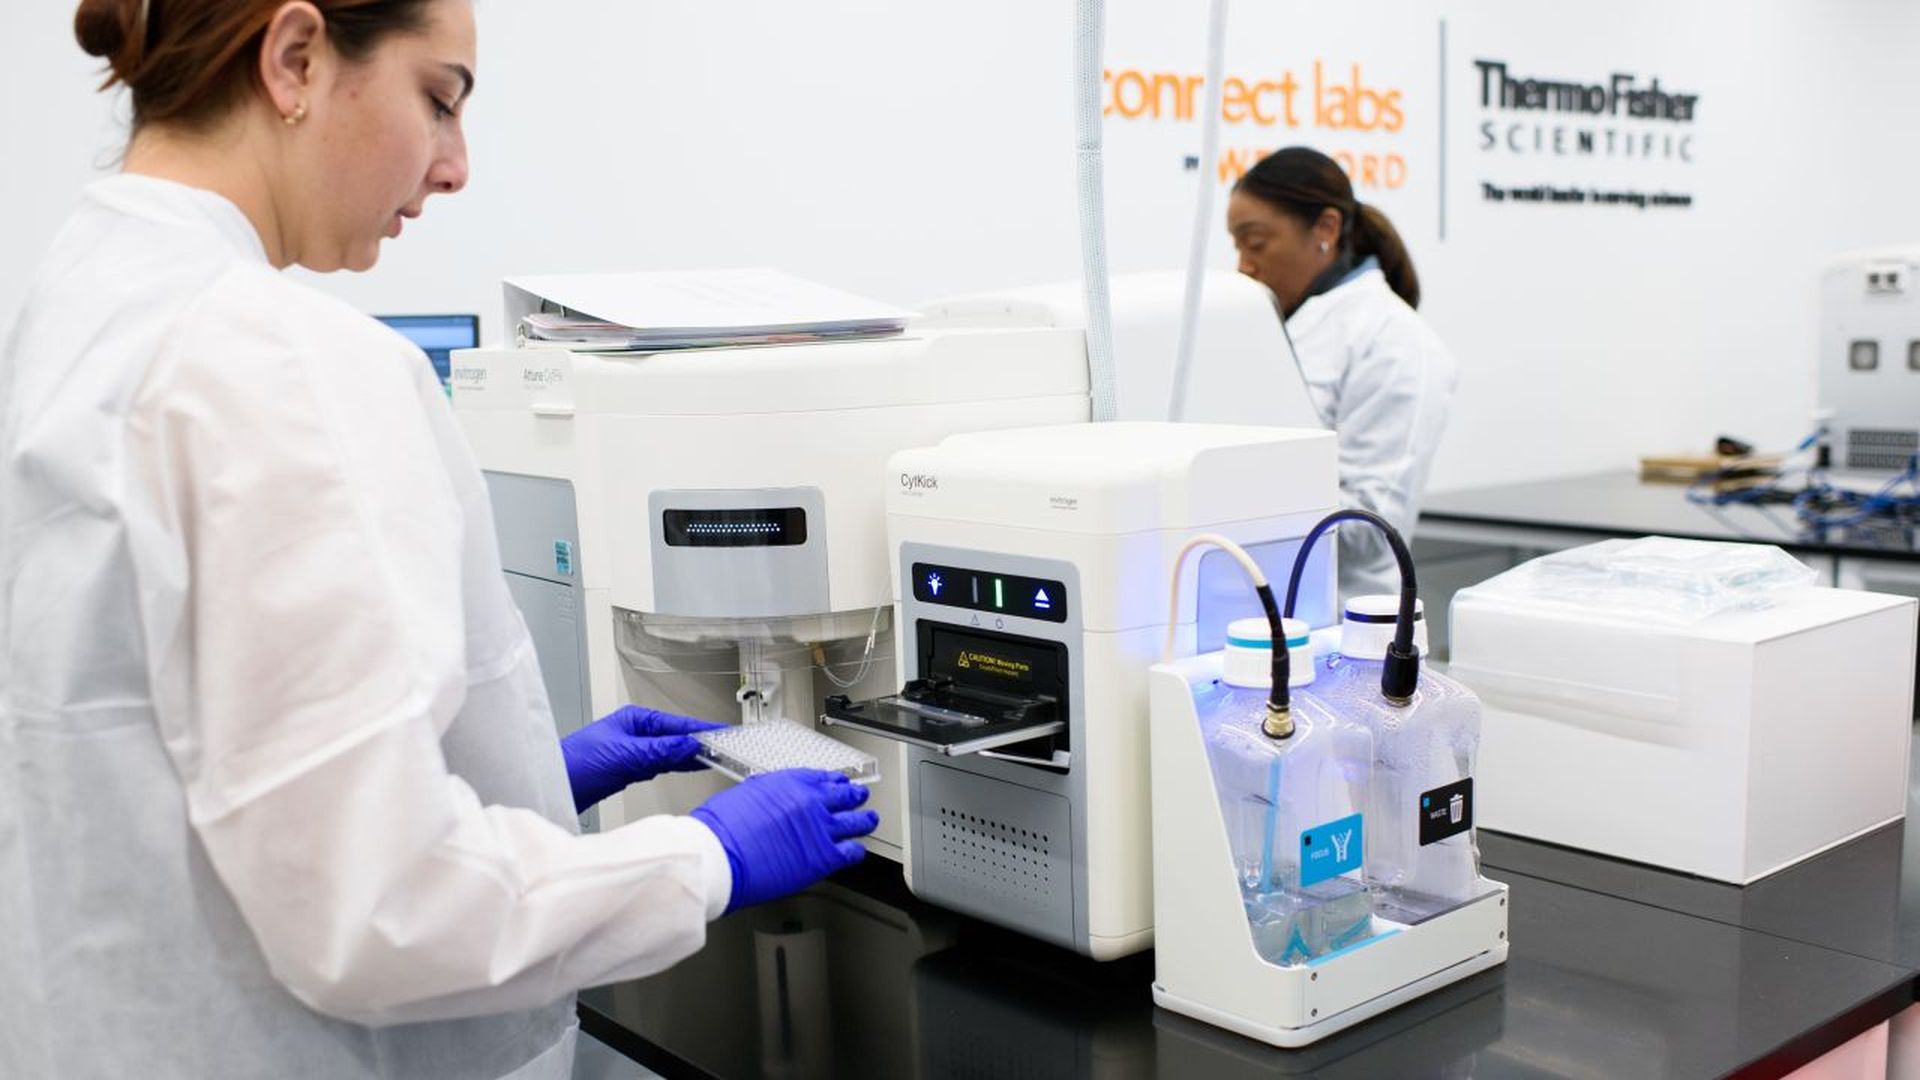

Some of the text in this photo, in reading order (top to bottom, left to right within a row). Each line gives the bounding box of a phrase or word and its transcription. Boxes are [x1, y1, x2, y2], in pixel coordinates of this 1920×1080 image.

[1314, 58, 1405, 132] labs
[1474, 60, 1698, 121] ThermoFisher
[1480, 122, 1693, 162] SCIENTIFIC
